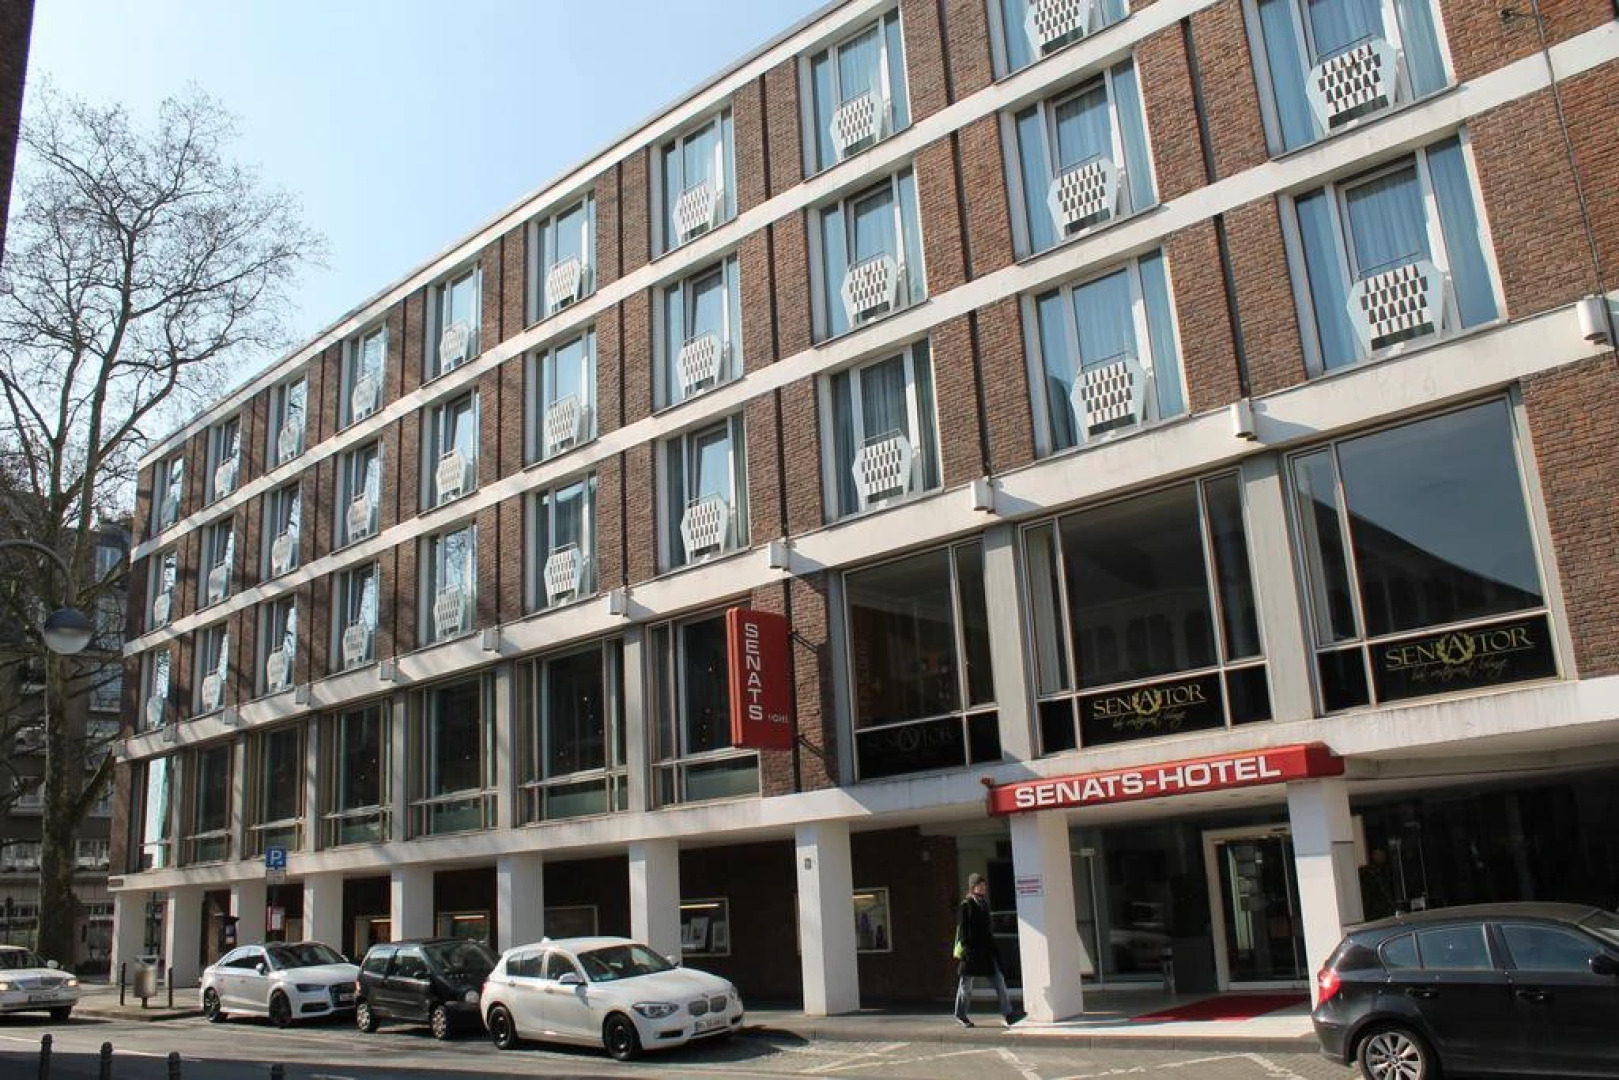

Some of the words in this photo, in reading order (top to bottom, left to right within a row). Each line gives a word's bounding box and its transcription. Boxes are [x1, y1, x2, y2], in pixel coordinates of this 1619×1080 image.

[1386, 627, 1533, 668] SENATOR
[744, 623, 763, 720] SENATS
[1093, 684, 1206, 715] SENATOR
[1014, 756, 1281, 807] SENATS-HOTEL
[271, 850, 283, 866] P
